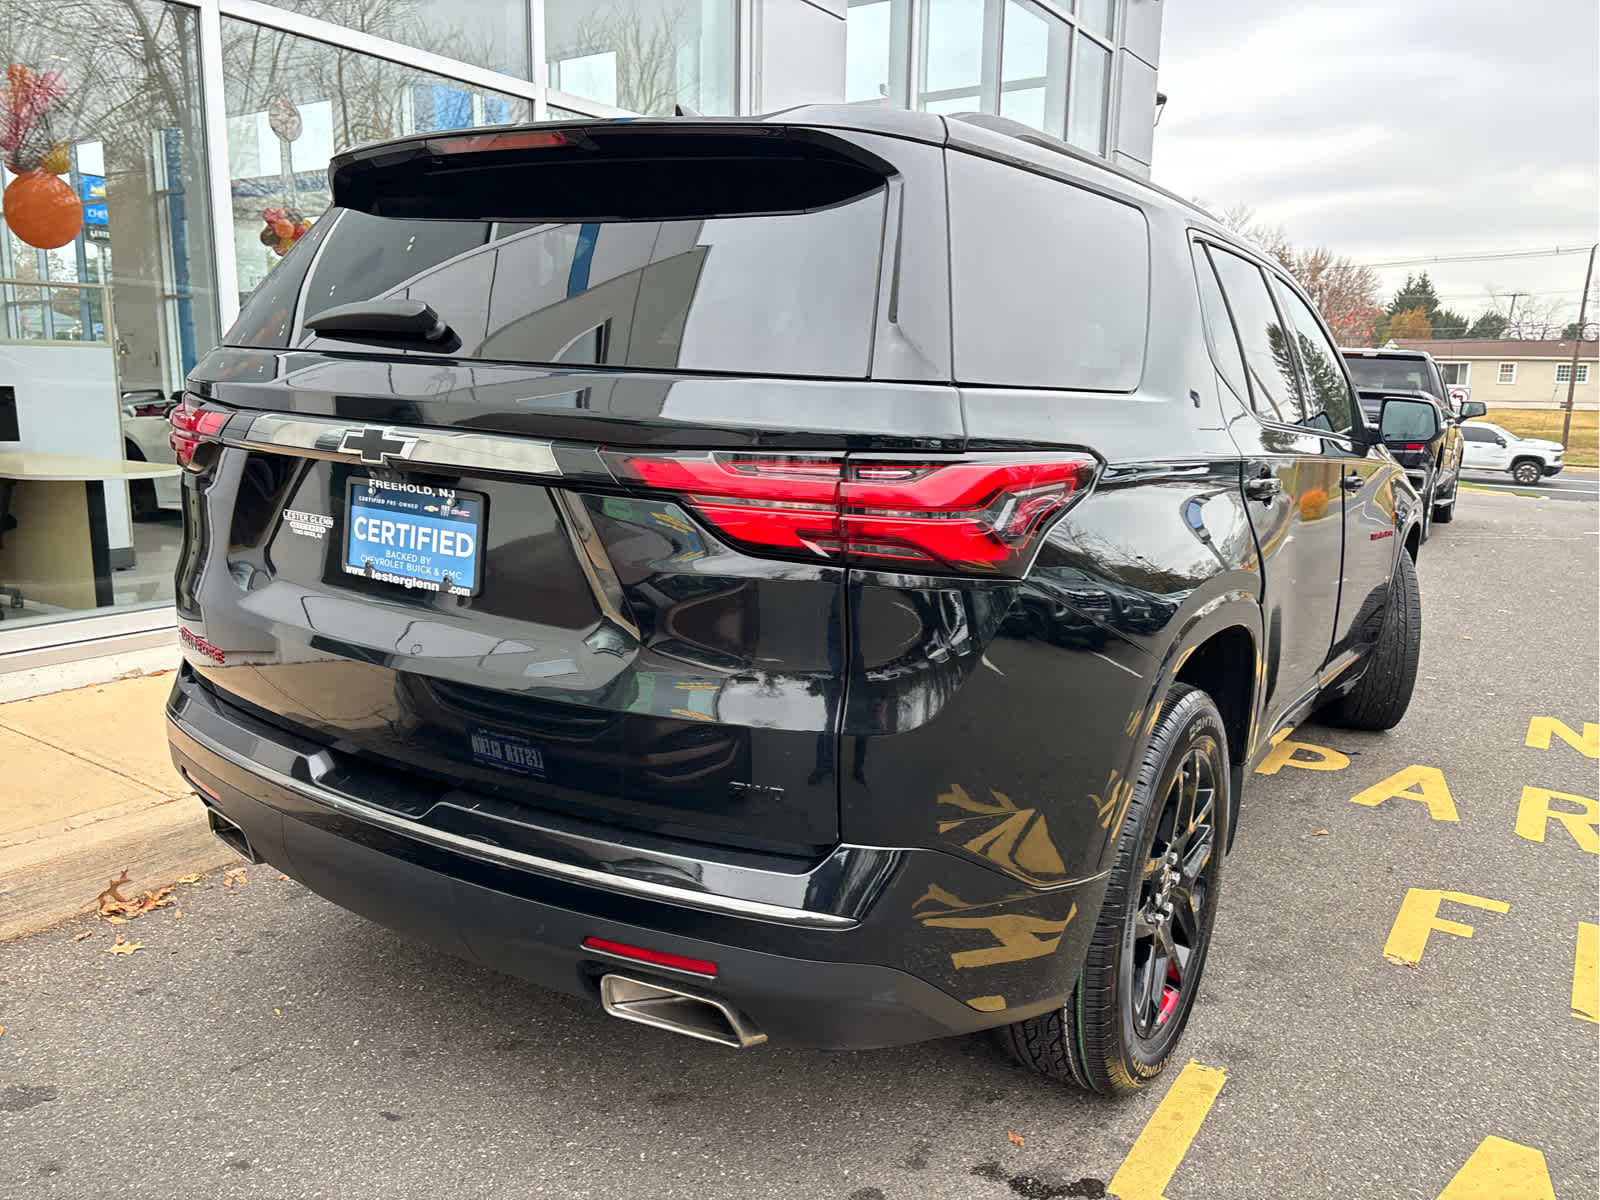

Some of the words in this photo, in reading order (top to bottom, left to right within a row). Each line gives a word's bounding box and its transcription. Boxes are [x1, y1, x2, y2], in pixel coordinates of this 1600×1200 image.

[369, 479, 436, 497] FREEHOLD,
[439, 488, 456, 498] NJ
[353, 516, 474, 558] CERTIFIED
[360, 554, 404, 569] CHEVROLET
[406, 562, 432, 576] BUICK
[433, 567, 440, 577] &
[442, 569, 463, 580] GMC
[385, 550, 418, 563] BACKED
[420, 555, 432, 565] BY
